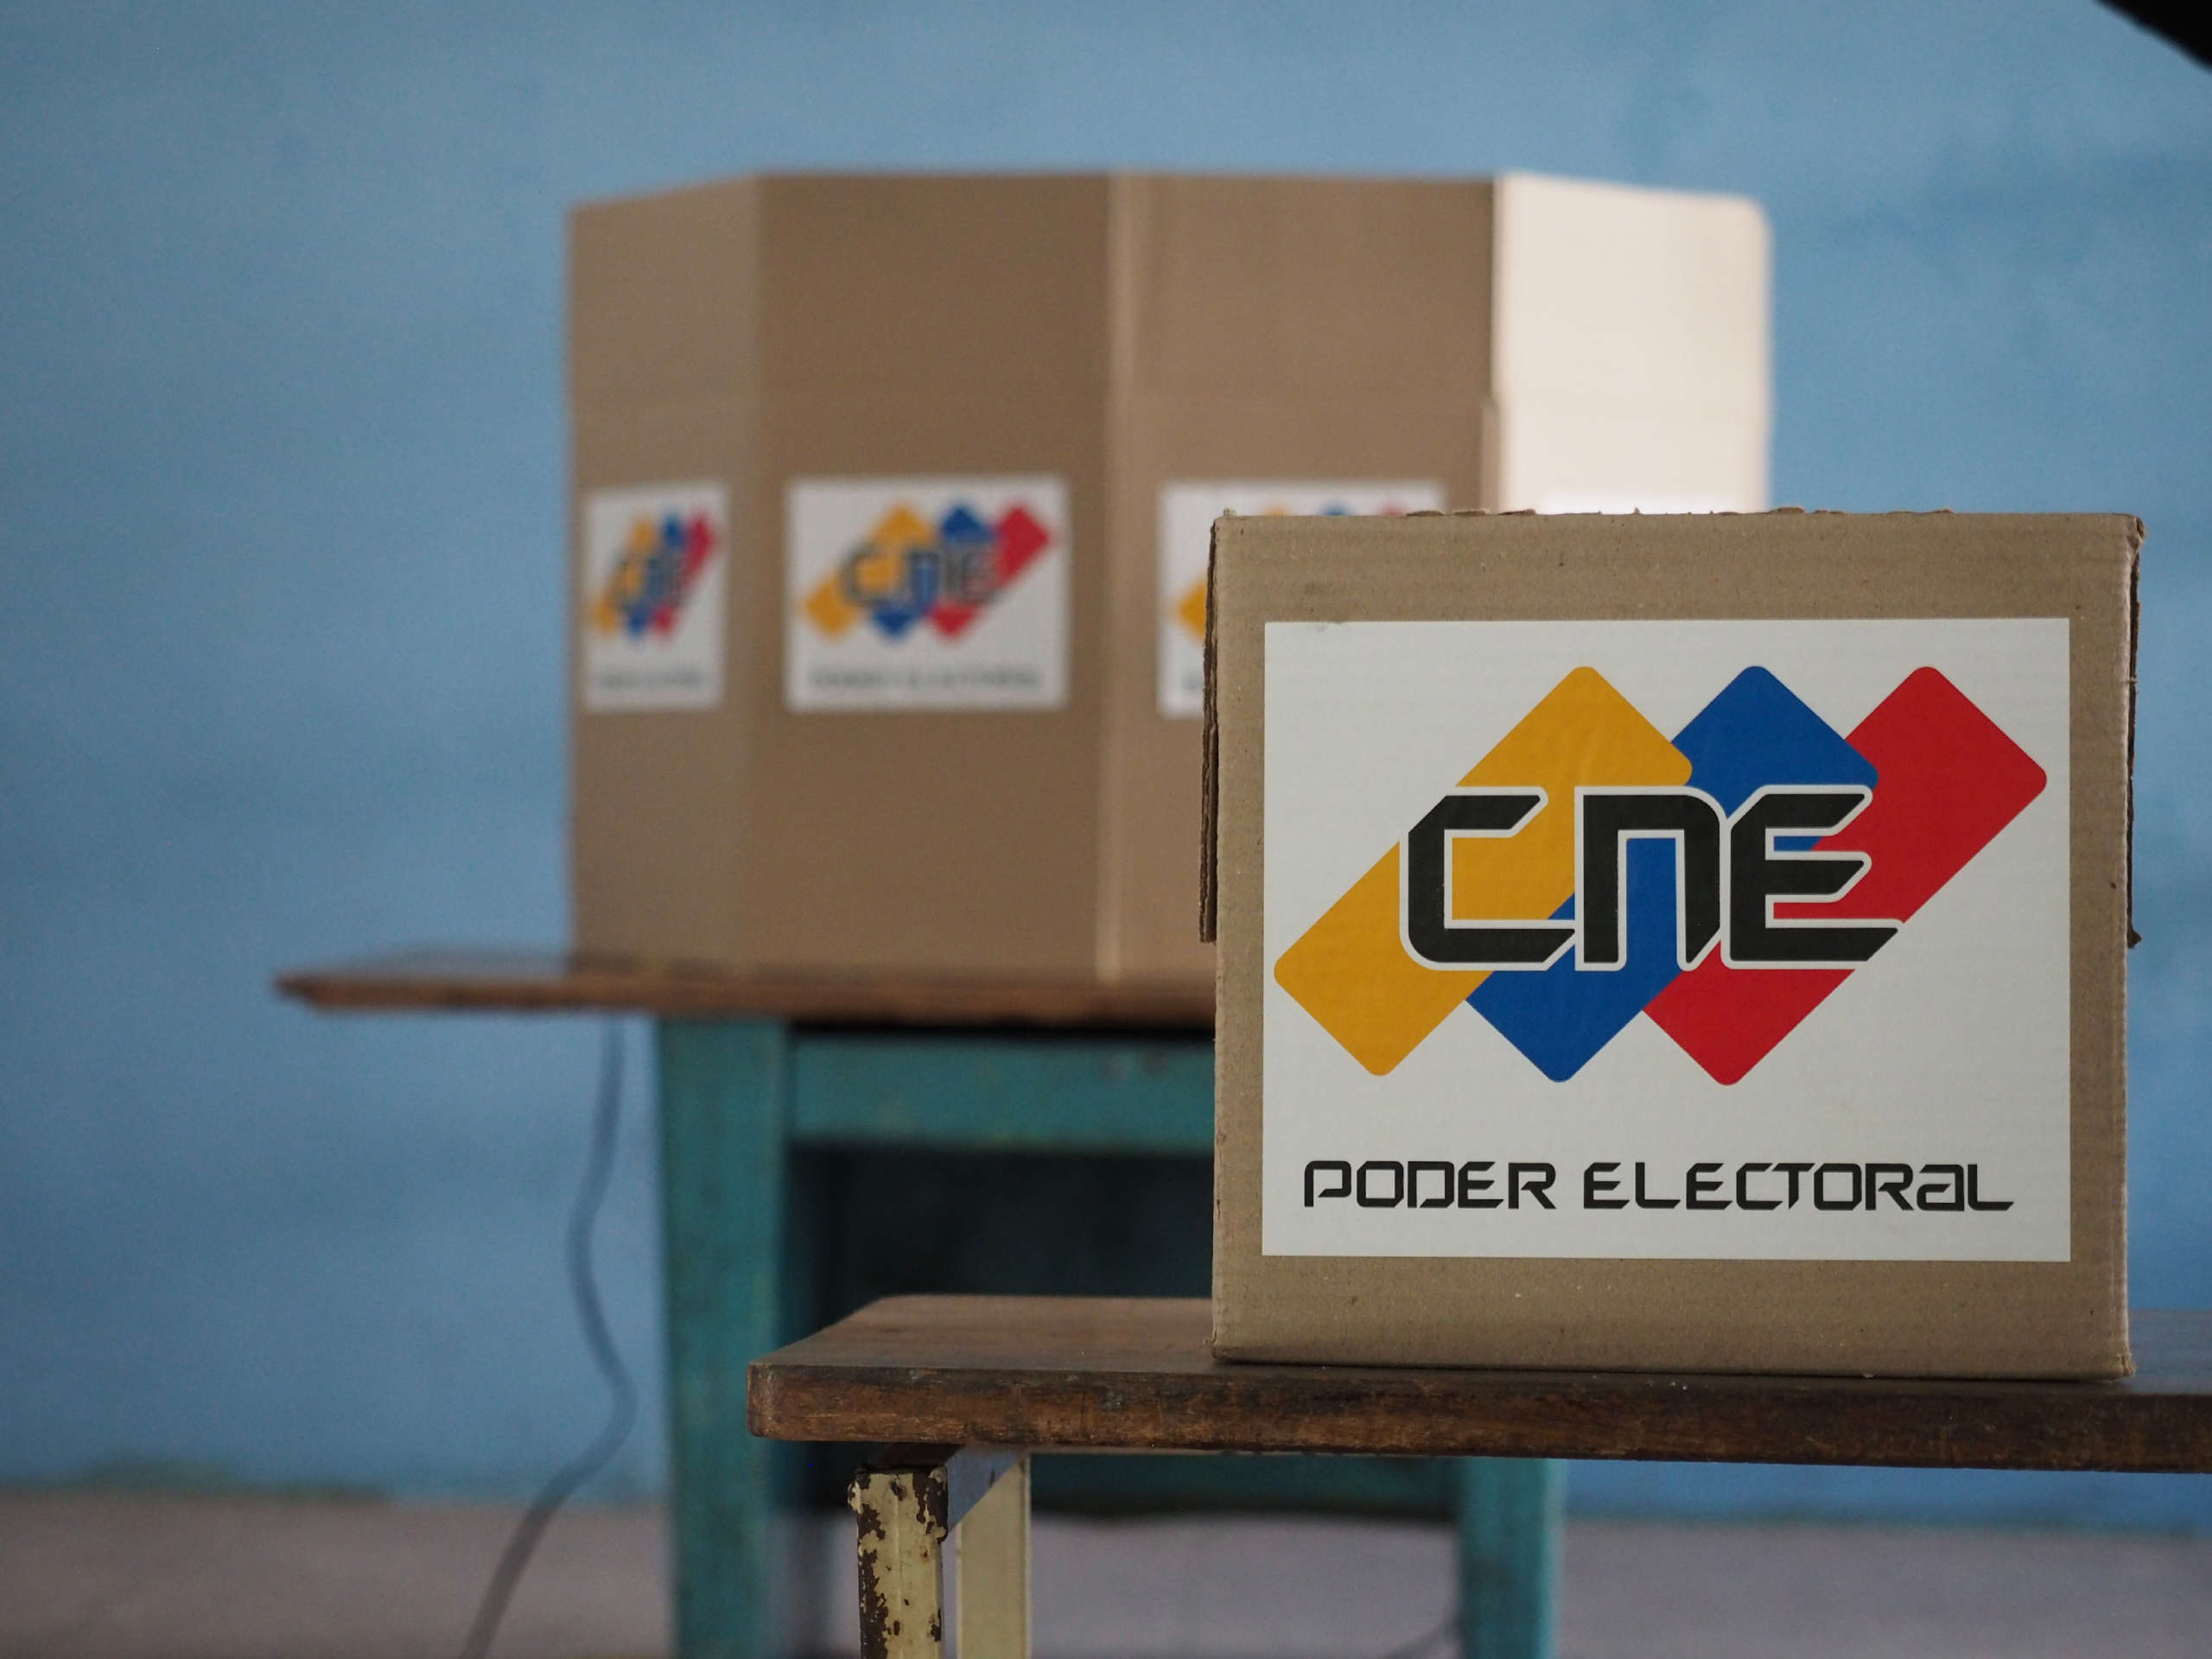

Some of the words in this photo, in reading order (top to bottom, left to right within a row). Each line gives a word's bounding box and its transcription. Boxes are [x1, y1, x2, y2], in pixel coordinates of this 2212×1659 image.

[1403, 790, 1900, 967] CNE
[1304, 1160, 1556, 1210] PODER
[1583, 1161, 2014, 1212] ELECTORAL
